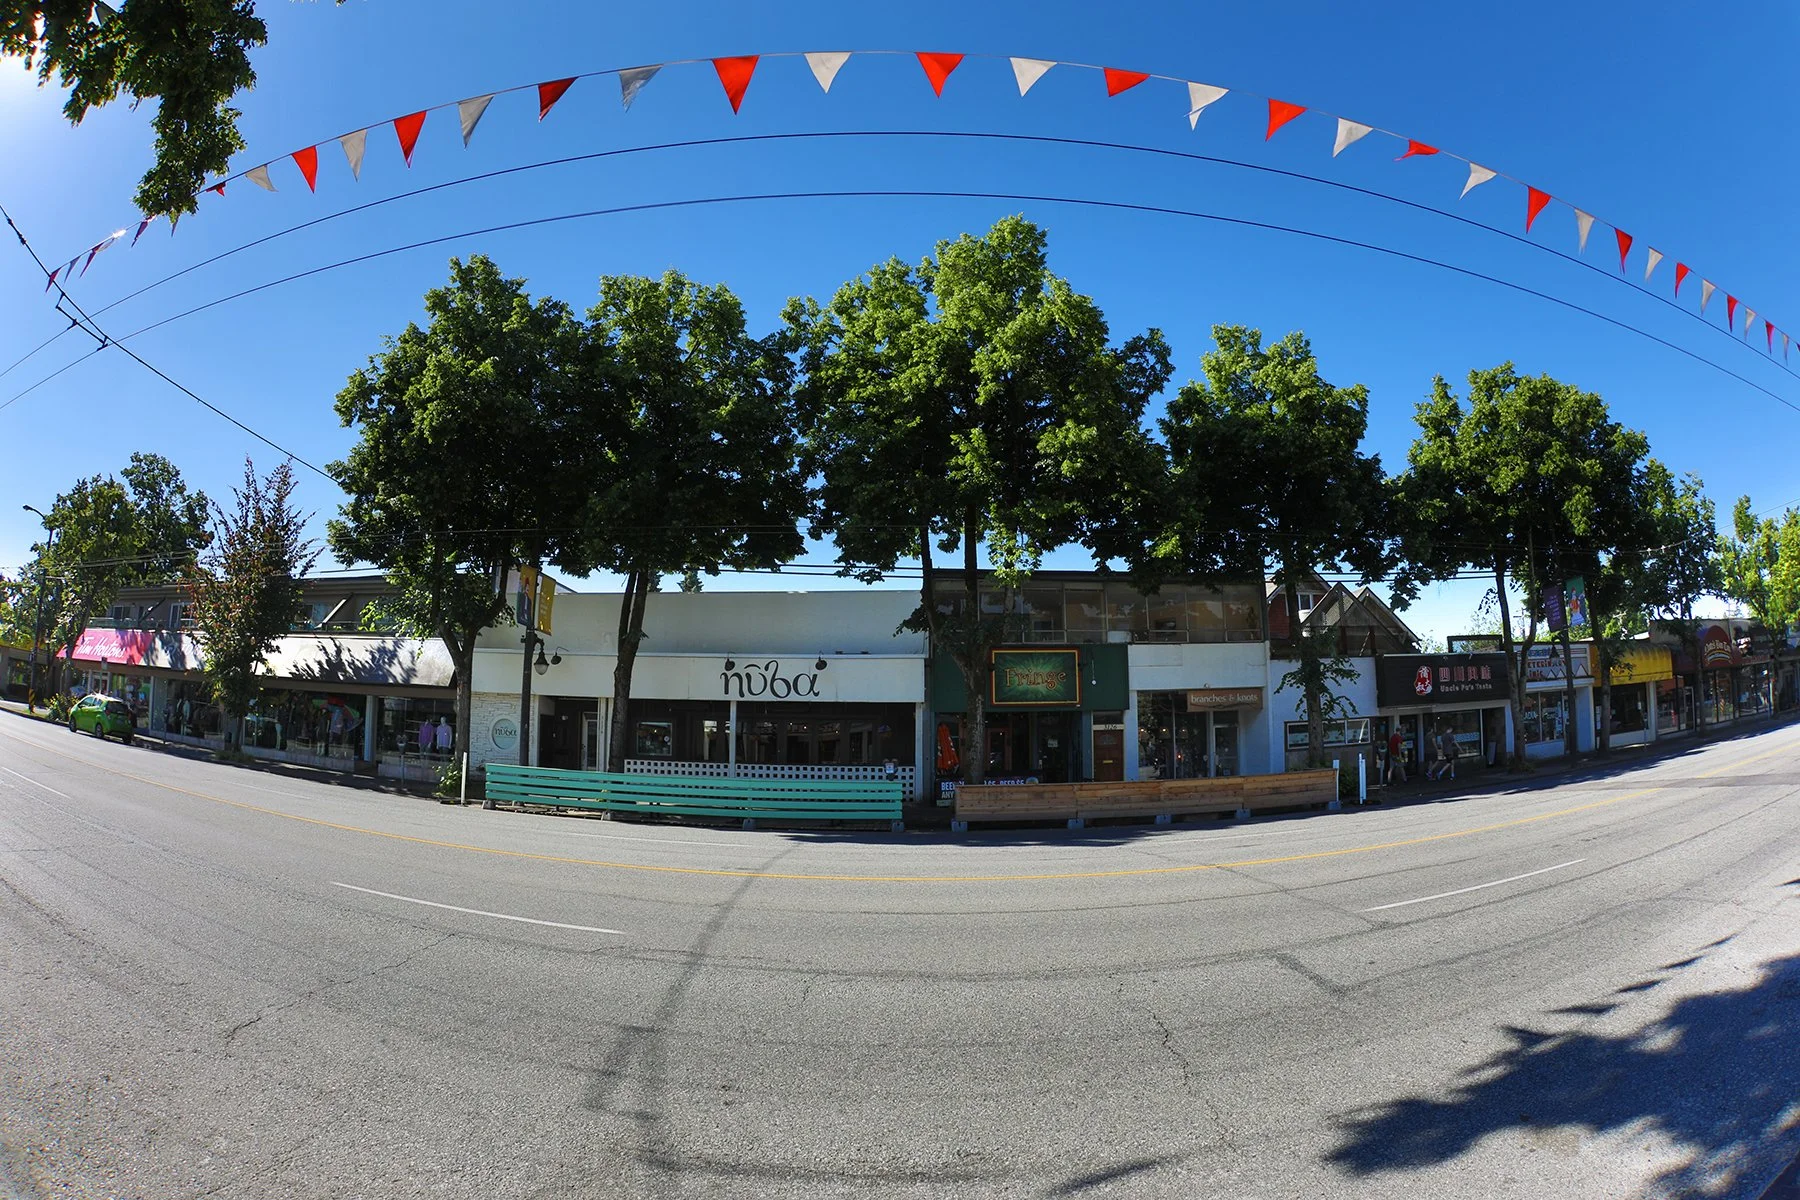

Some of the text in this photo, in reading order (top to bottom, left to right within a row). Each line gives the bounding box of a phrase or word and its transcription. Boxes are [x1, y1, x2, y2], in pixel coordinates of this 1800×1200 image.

[77, 637, 94, 655] Tim
[1004, 667, 1066, 690] Fringe
[1191, 693, 1227, 703] branches
[1237, 693, 1258, 702] knots
